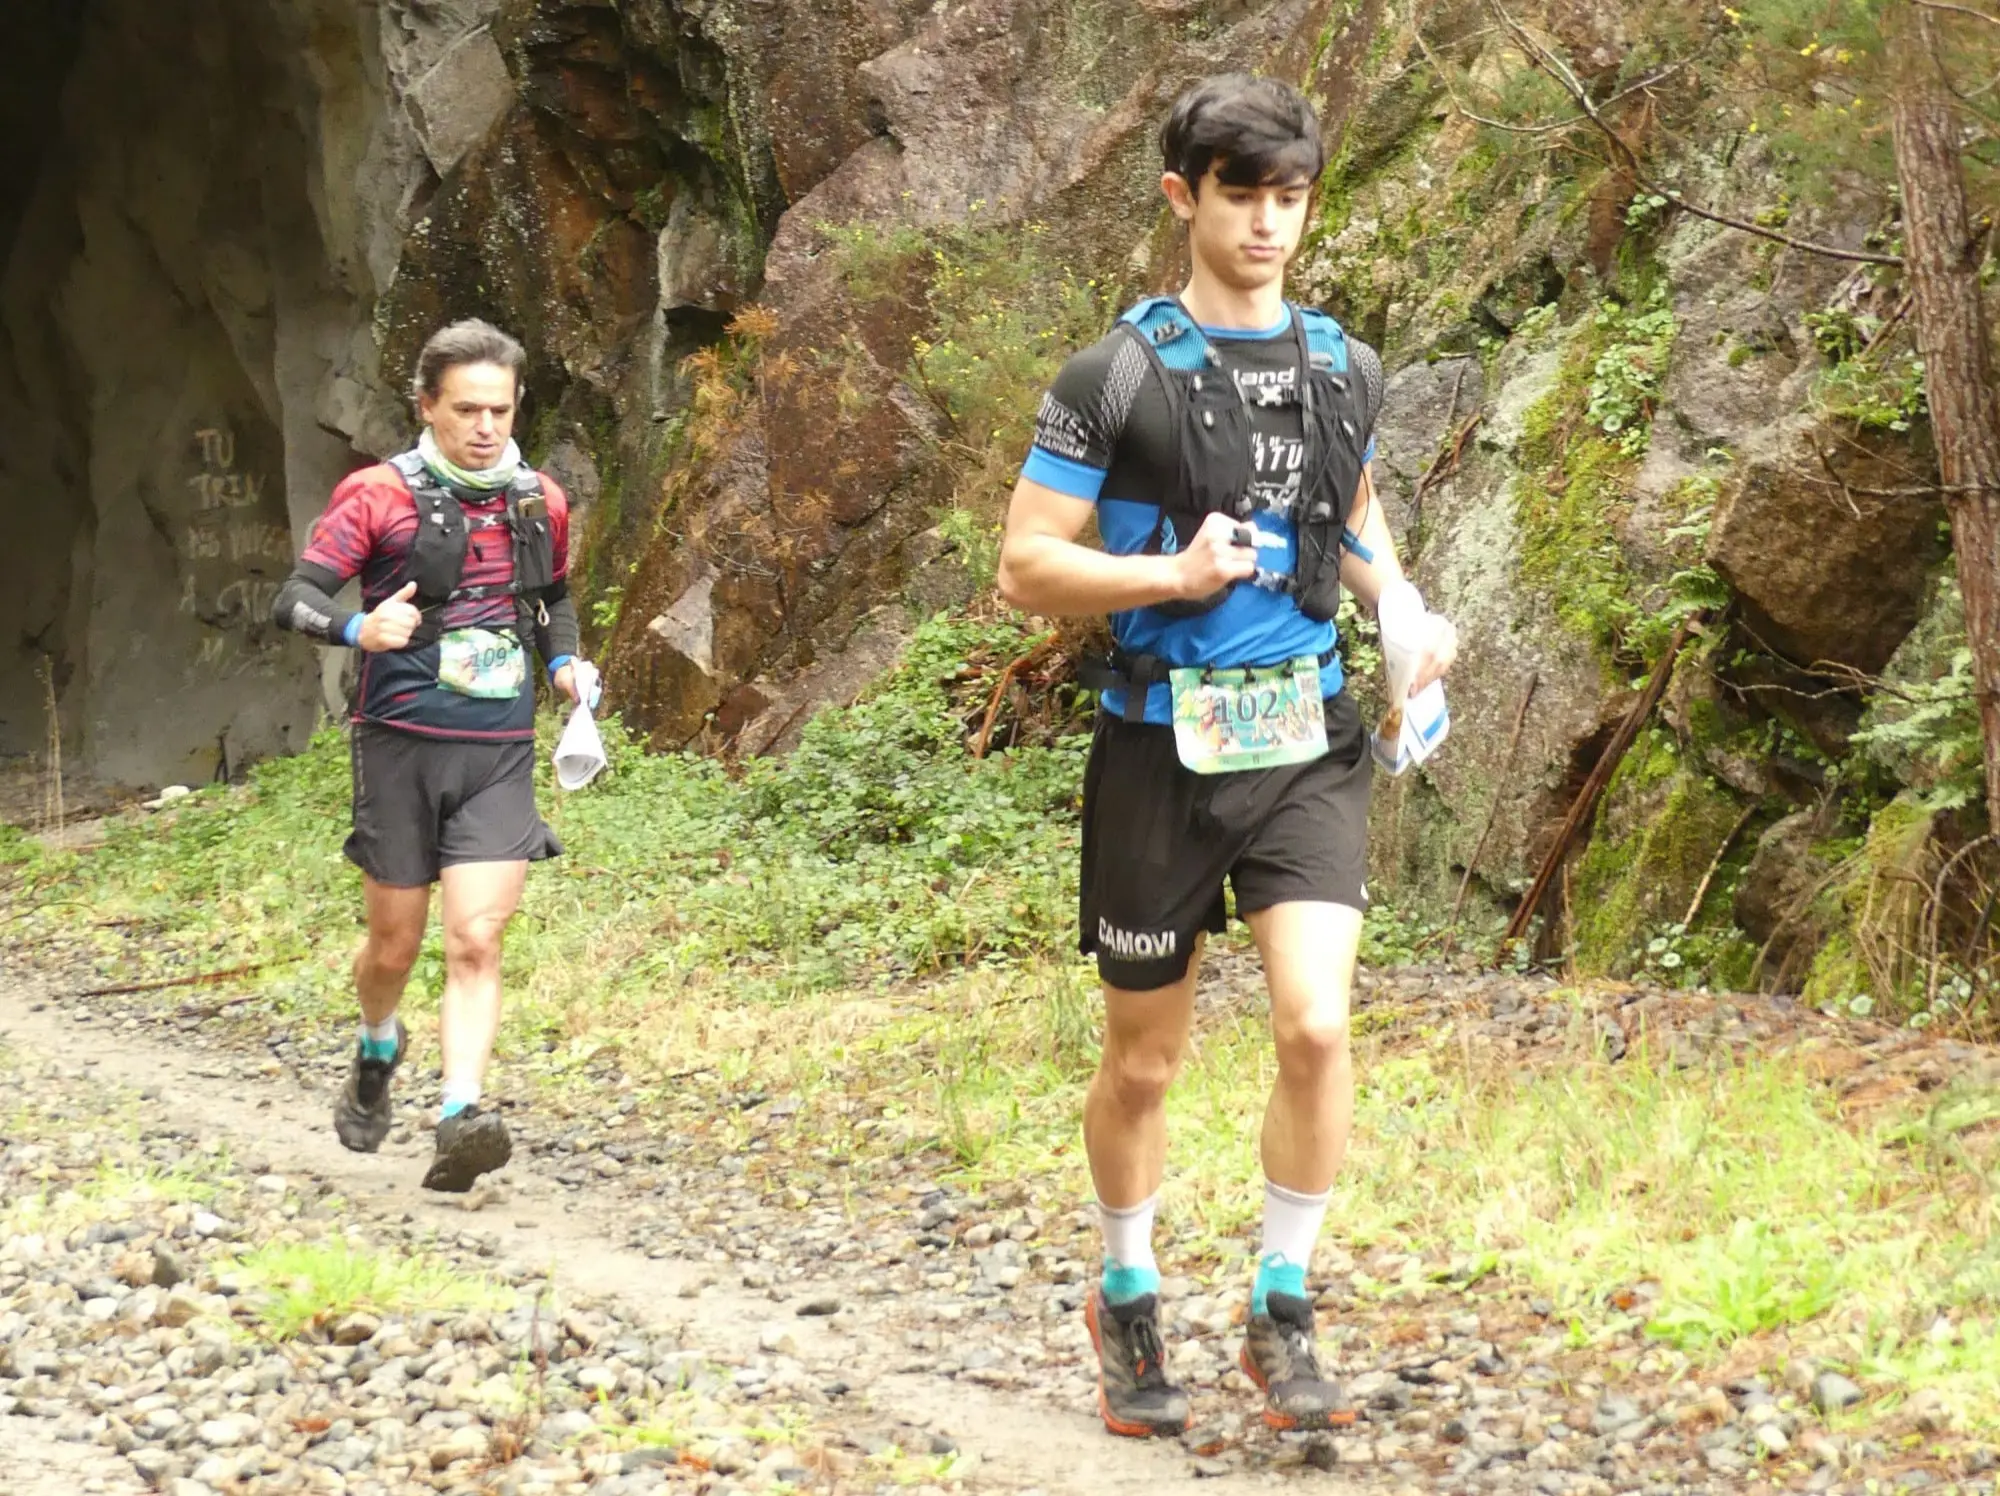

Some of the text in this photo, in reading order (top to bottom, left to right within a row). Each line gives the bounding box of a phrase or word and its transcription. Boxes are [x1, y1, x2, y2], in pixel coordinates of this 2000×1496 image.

[195, 428, 235, 468] TU
[1254, 444, 1303, 472] ATU
[470, 646, 508, 668] 109
[1214, 688, 1280, 725] 102
[1099, 916, 1177, 957] CAMOVI
